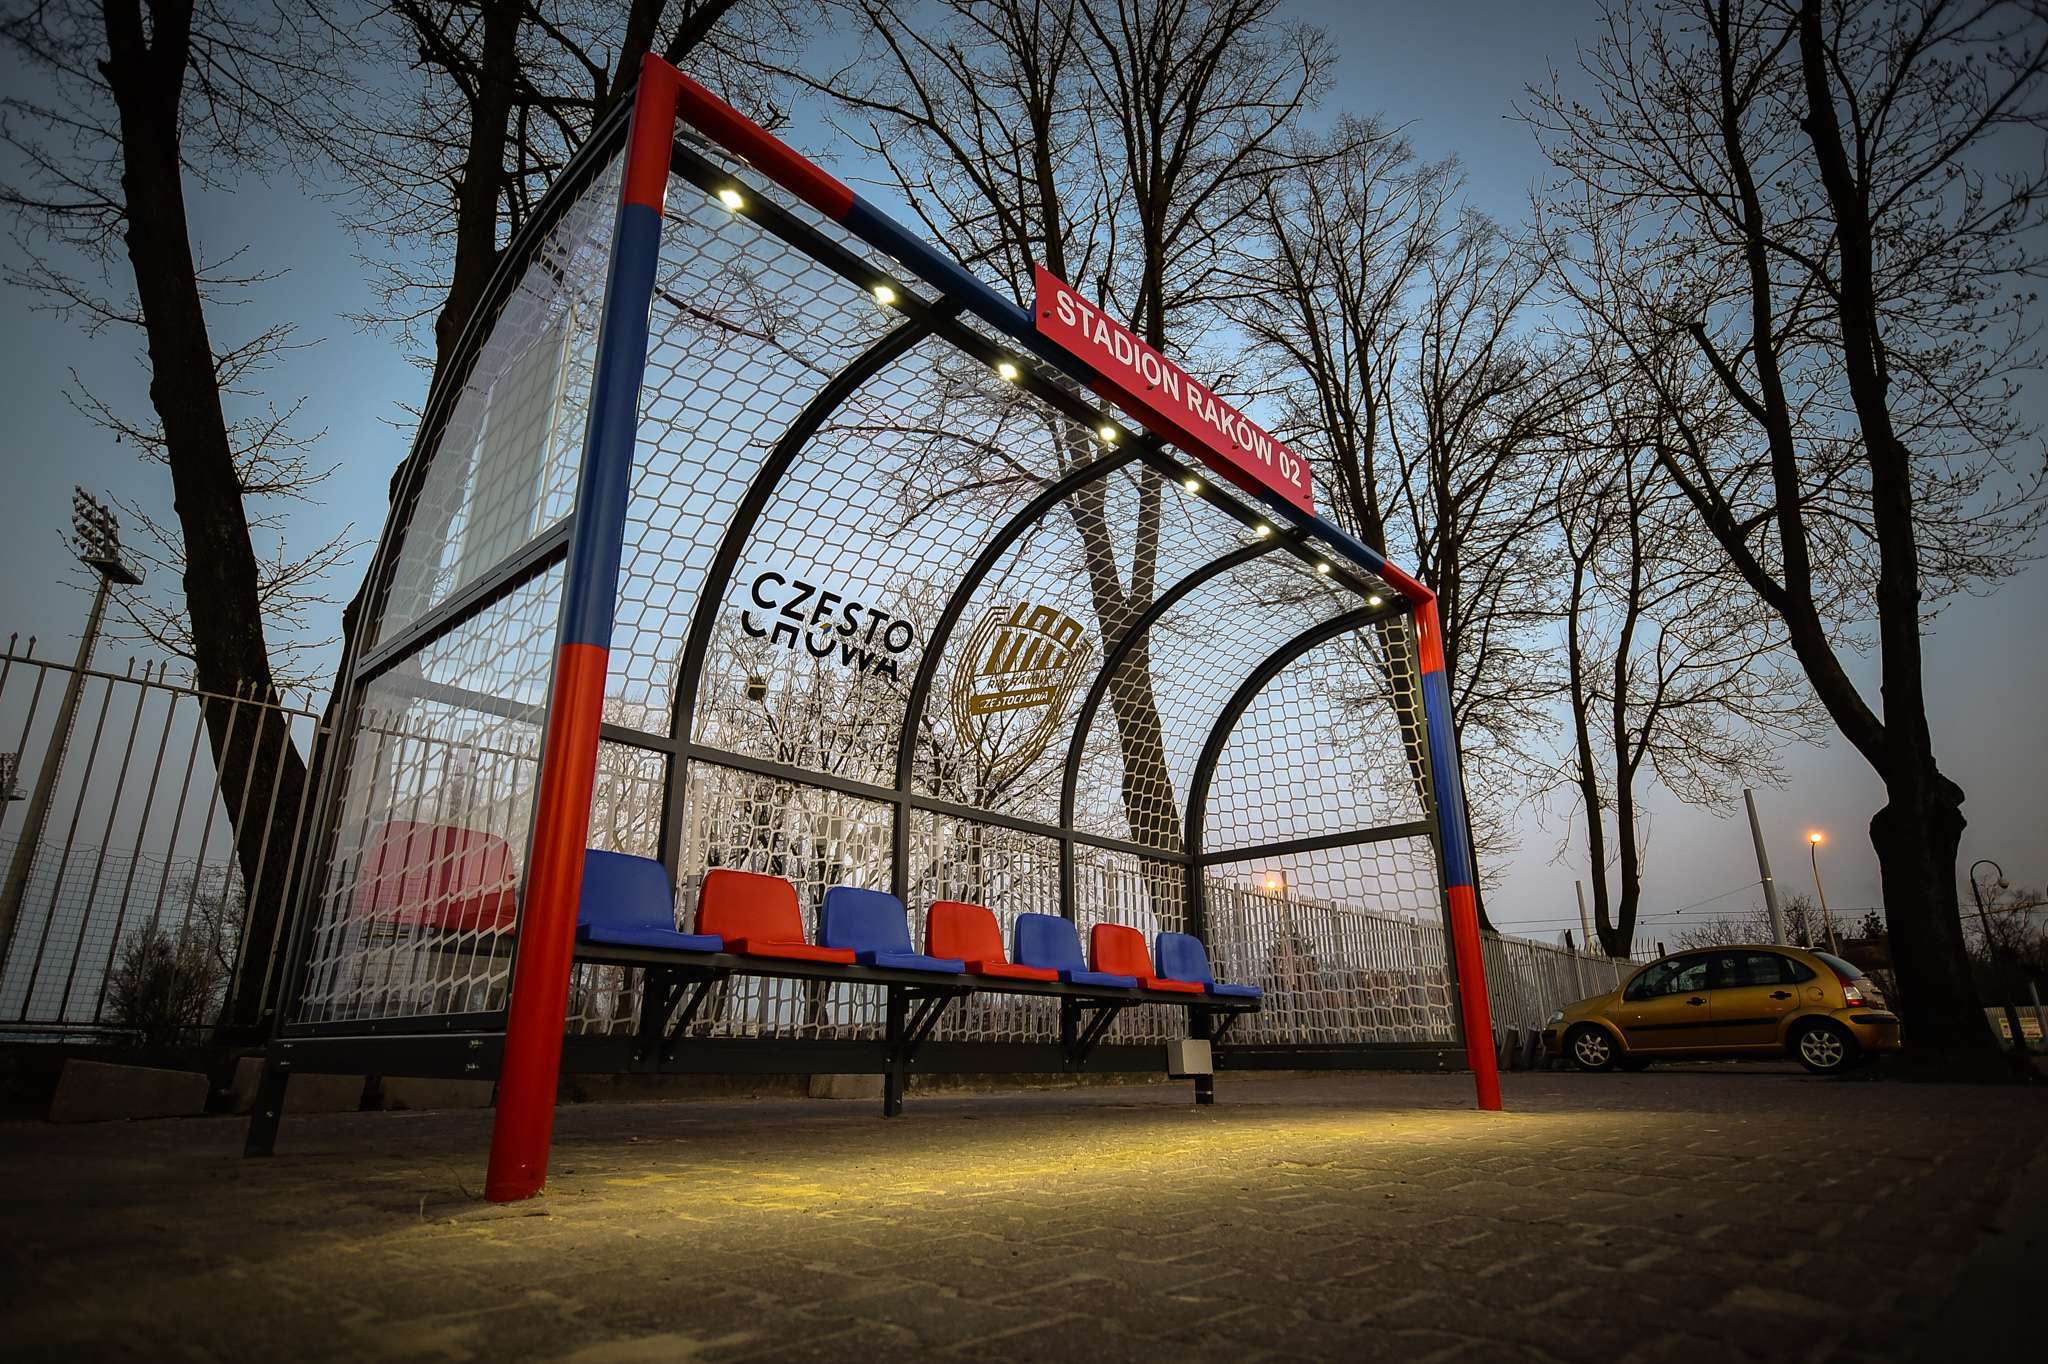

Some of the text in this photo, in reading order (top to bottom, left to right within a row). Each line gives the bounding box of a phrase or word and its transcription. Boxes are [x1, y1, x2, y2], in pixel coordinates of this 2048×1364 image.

[1056, 290, 1302, 488] STADION RAKÓW 02
